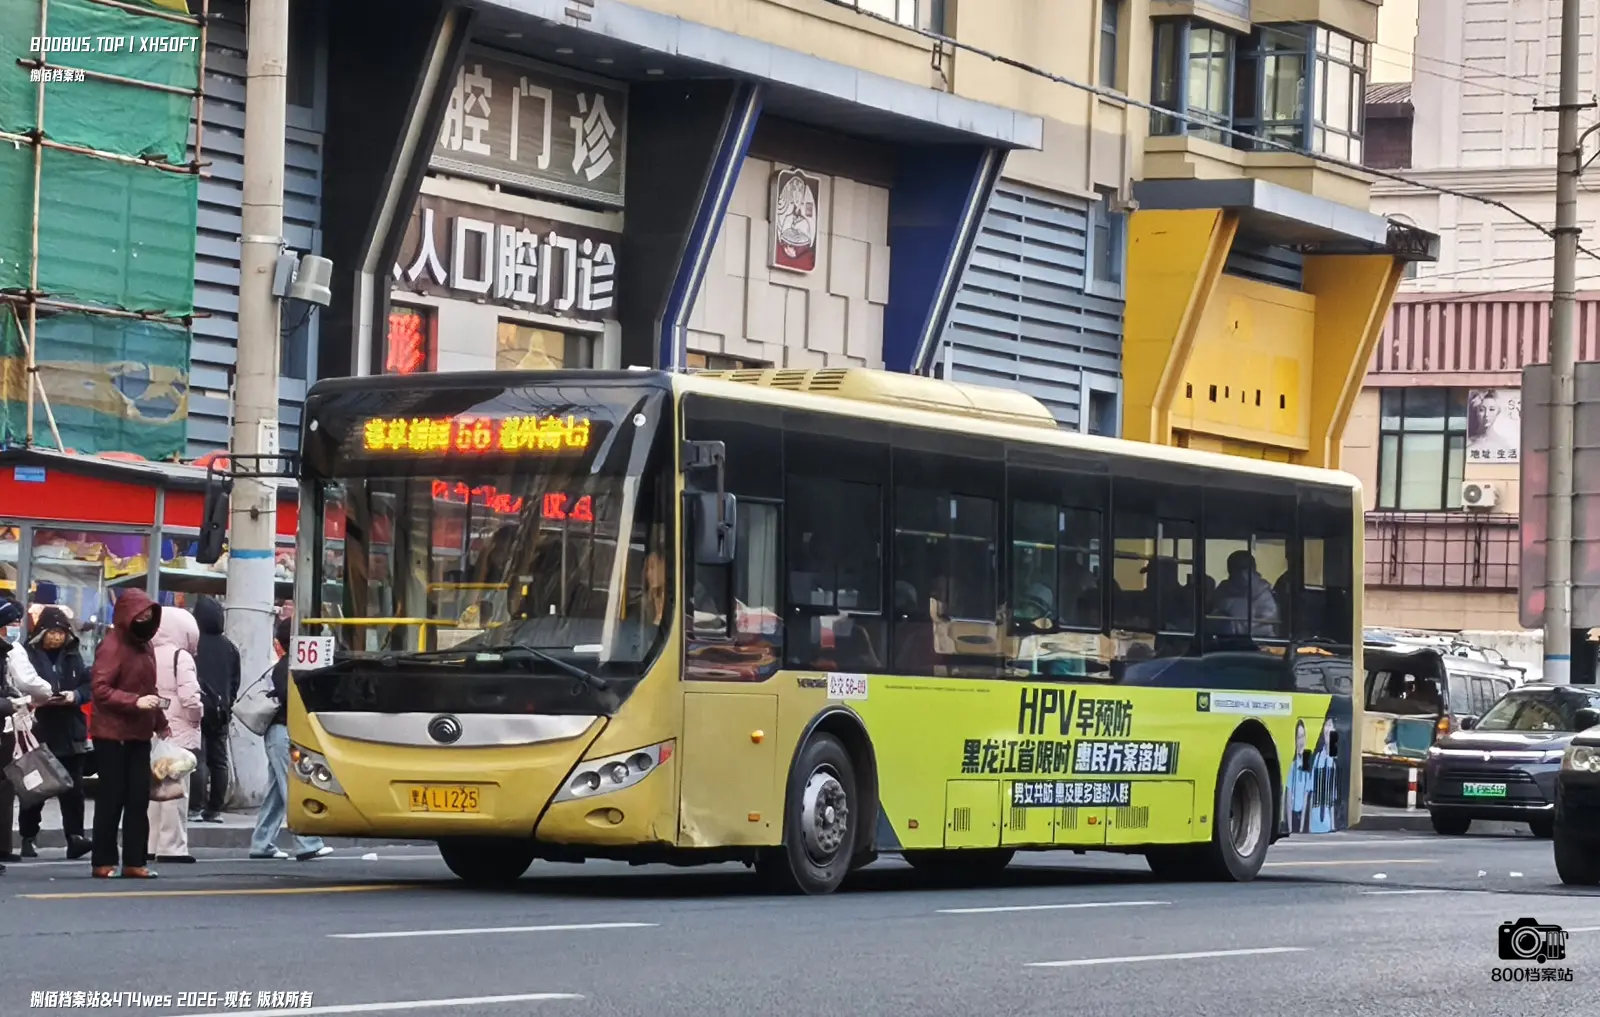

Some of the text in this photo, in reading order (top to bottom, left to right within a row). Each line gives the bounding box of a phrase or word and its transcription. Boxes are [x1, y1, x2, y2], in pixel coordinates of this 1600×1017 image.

[393, 208, 616, 312] 人口腔门诊
[297, 640, 318, 664] 56
